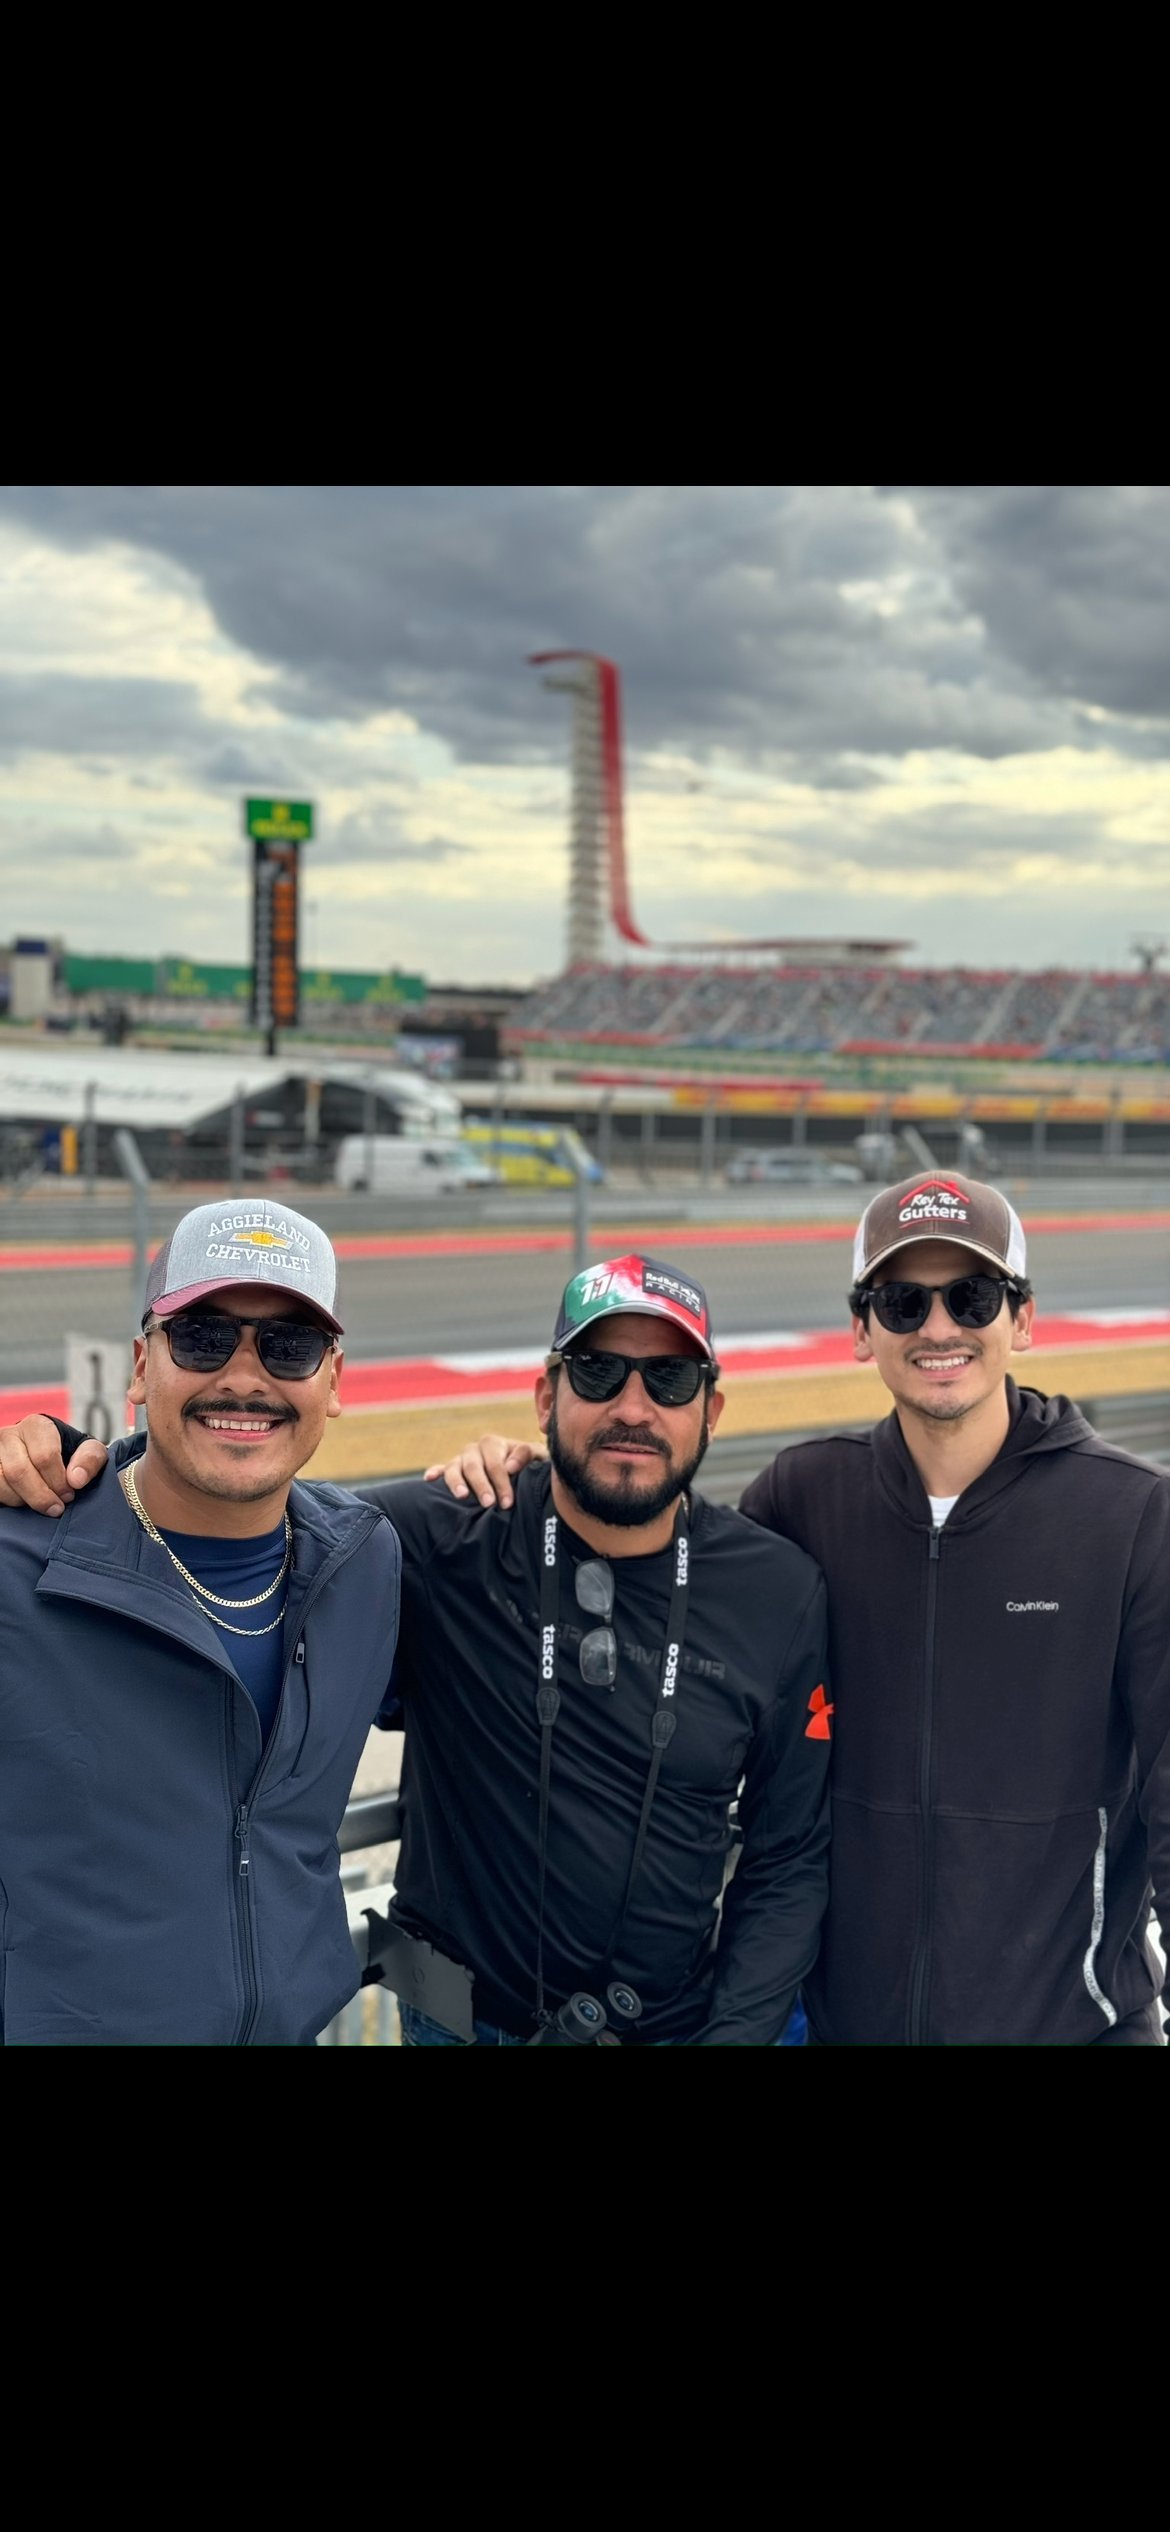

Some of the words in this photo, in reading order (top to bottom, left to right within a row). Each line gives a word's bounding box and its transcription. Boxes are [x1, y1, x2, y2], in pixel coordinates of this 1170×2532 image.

[899, 1203, 967, 1222] Gutters
[937, 1192, 960, 1206] Tex
[207, 1213, 311, 1251] AGGIELAND
[205, 1243, 311, 1273] CHEVROLET
[544, 1515, 558, 1566] tasco
[675, 1537, 688, 1587] tasco
[542, 1624, 556, 1679] tasco
[661, 1642, 680, 1698] tasco
